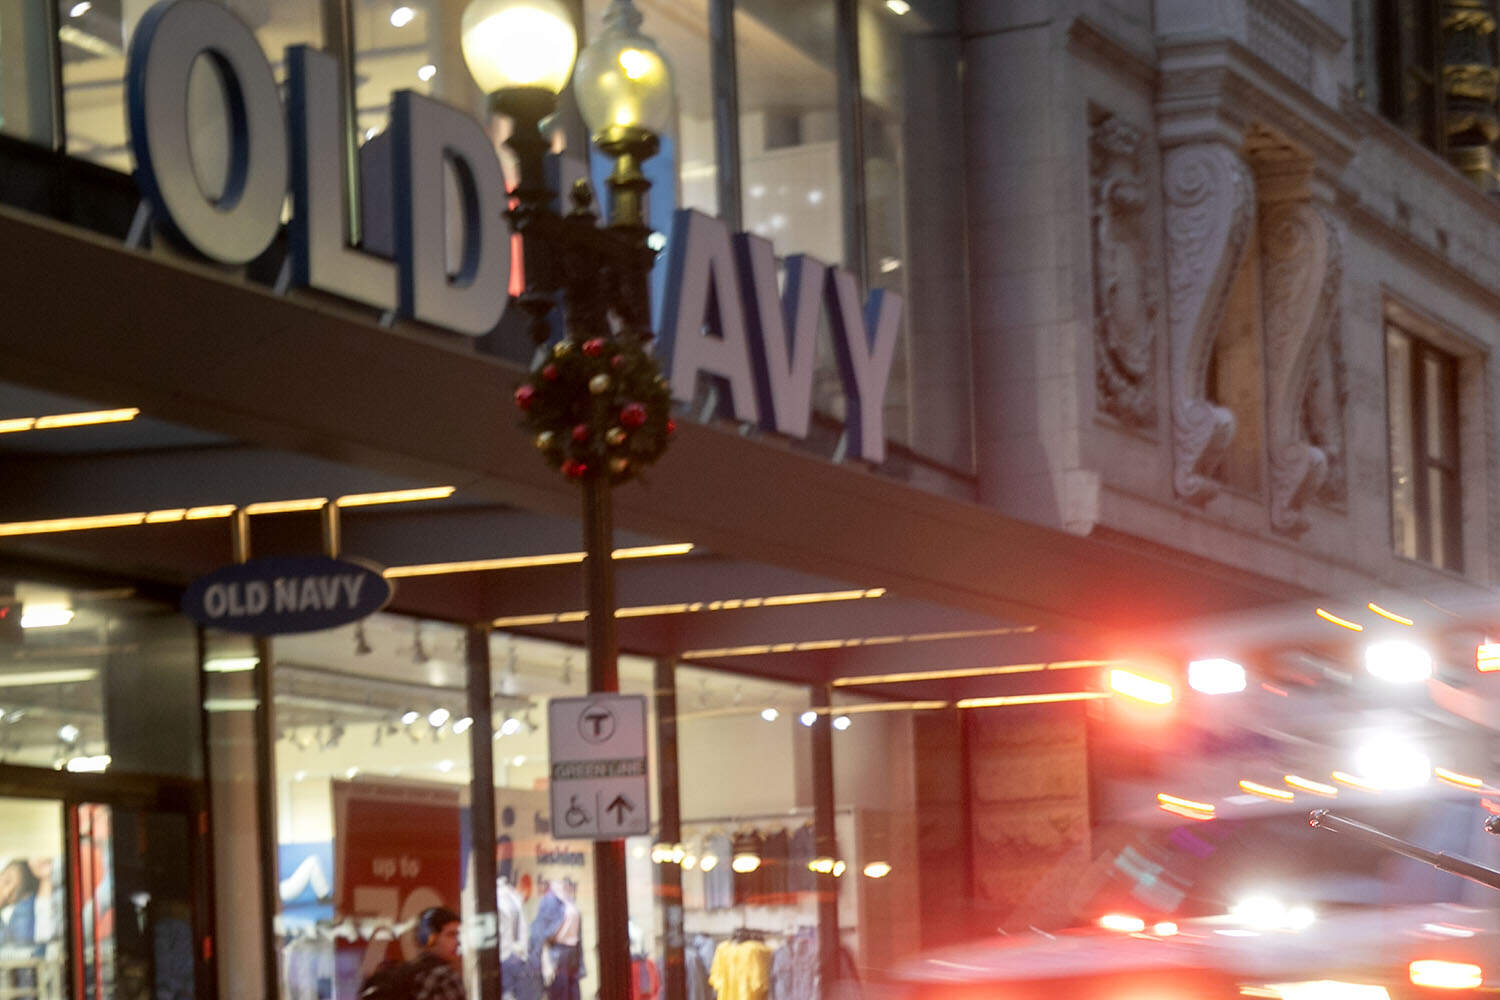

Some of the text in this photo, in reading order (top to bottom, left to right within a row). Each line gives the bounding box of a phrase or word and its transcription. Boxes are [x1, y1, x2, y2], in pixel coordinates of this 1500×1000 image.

[127, 0, 513, 337] OLD
[203, 573, 367, 619] OLD NAVY
[584, 714, 609, 736] T
[372, 856, 420, 879] up to
